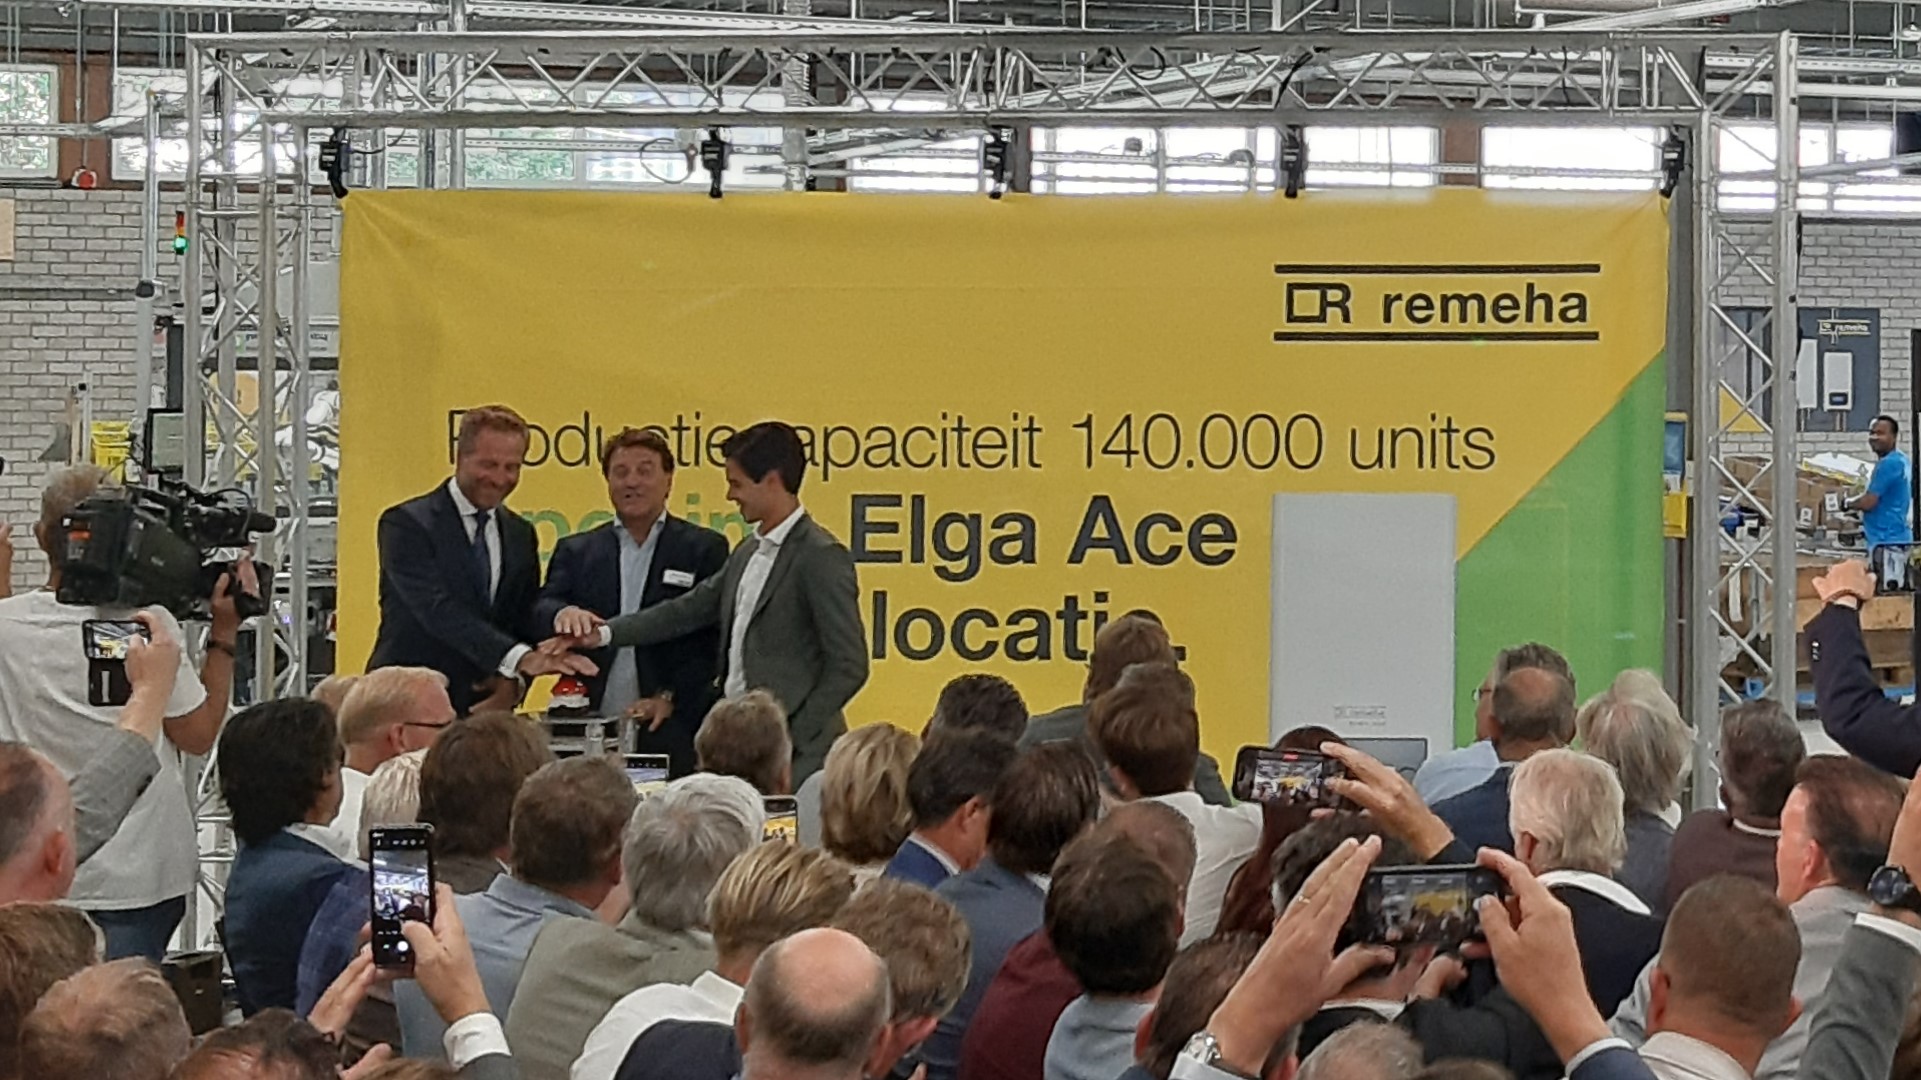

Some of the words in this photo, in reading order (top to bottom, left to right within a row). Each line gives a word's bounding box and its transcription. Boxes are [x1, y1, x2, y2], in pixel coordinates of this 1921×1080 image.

[1382, 282, 1588, 324] remeha
[448, 409, 1042, 482] Podtieapaciteit
[1072, 413, 1324, 470] 140.000
[1350, 413, 1496, 470] units
[851, 494, 1036, 582] Elga
[1066, 494, 1238, 566] Ace
